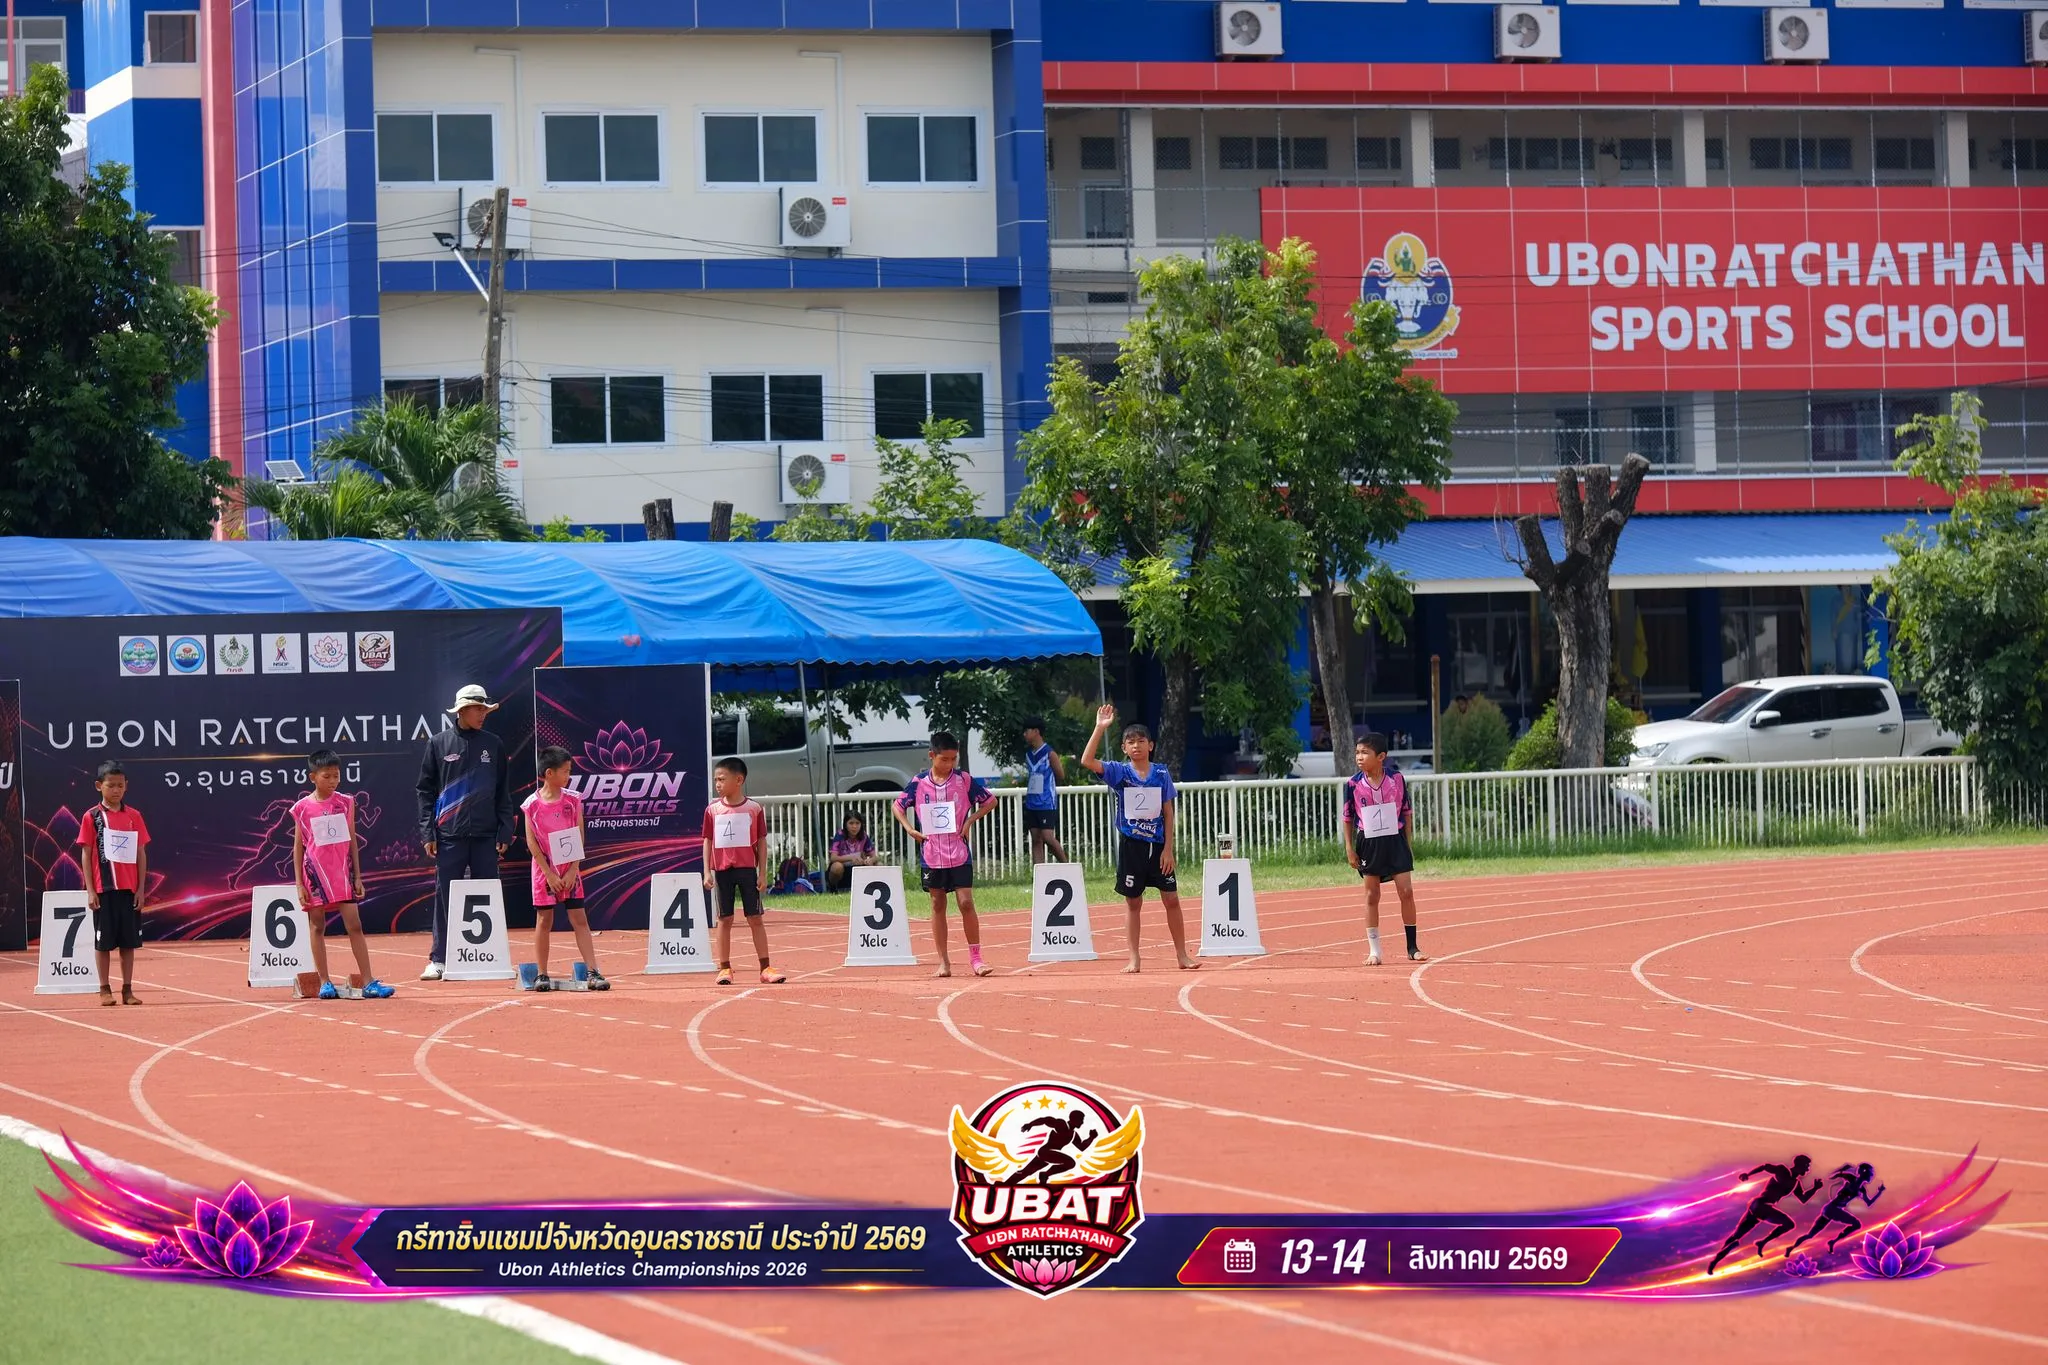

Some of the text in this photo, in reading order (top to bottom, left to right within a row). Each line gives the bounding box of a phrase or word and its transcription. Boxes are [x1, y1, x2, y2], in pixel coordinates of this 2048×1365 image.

[1526, 241, 2045, 287] UBONRATCHATHAN
[1591, 303, 2024, 352] SPORTS SCHOOL
[48, 718, 176, 749] UBON
[165, 761, 361, 794] จ.อุบลราชนี
[567, 771, 687, 800] UBON
[581, 799, 682, 816] THLETICS
[1134, 792, 1149, 811] 2
[327, 819, 337, 837] 6
[933, 806, 950, 828] 3
[1372, 808, 1390, 832] 1
[723, 820, 735, 840] 4
[111, 835, 129, 854] 7
[559, 835, 573, 858] 5
[1125, 875, 1135, 887] 5
[863, 881, 893, 930] 3
[1044, 879, 1075, 927] 2
[1218, 872, 1239, 921] 1
[265, 898, 297, 949] 6
[461, 894, 493, 944] 5
[663, 888, 694, 938] 4
[53, 907, 86, 957] 7
[1042, 931, 1077, 945] Nelco
[1211, 923, 1245, 938] Nelco
[261, 952, 298, 967] Nelco
[457, 948, 494, 963] Nelco
[660, 941, 696, 956] Nelco
[51, 961, 89, 976] Nelco
